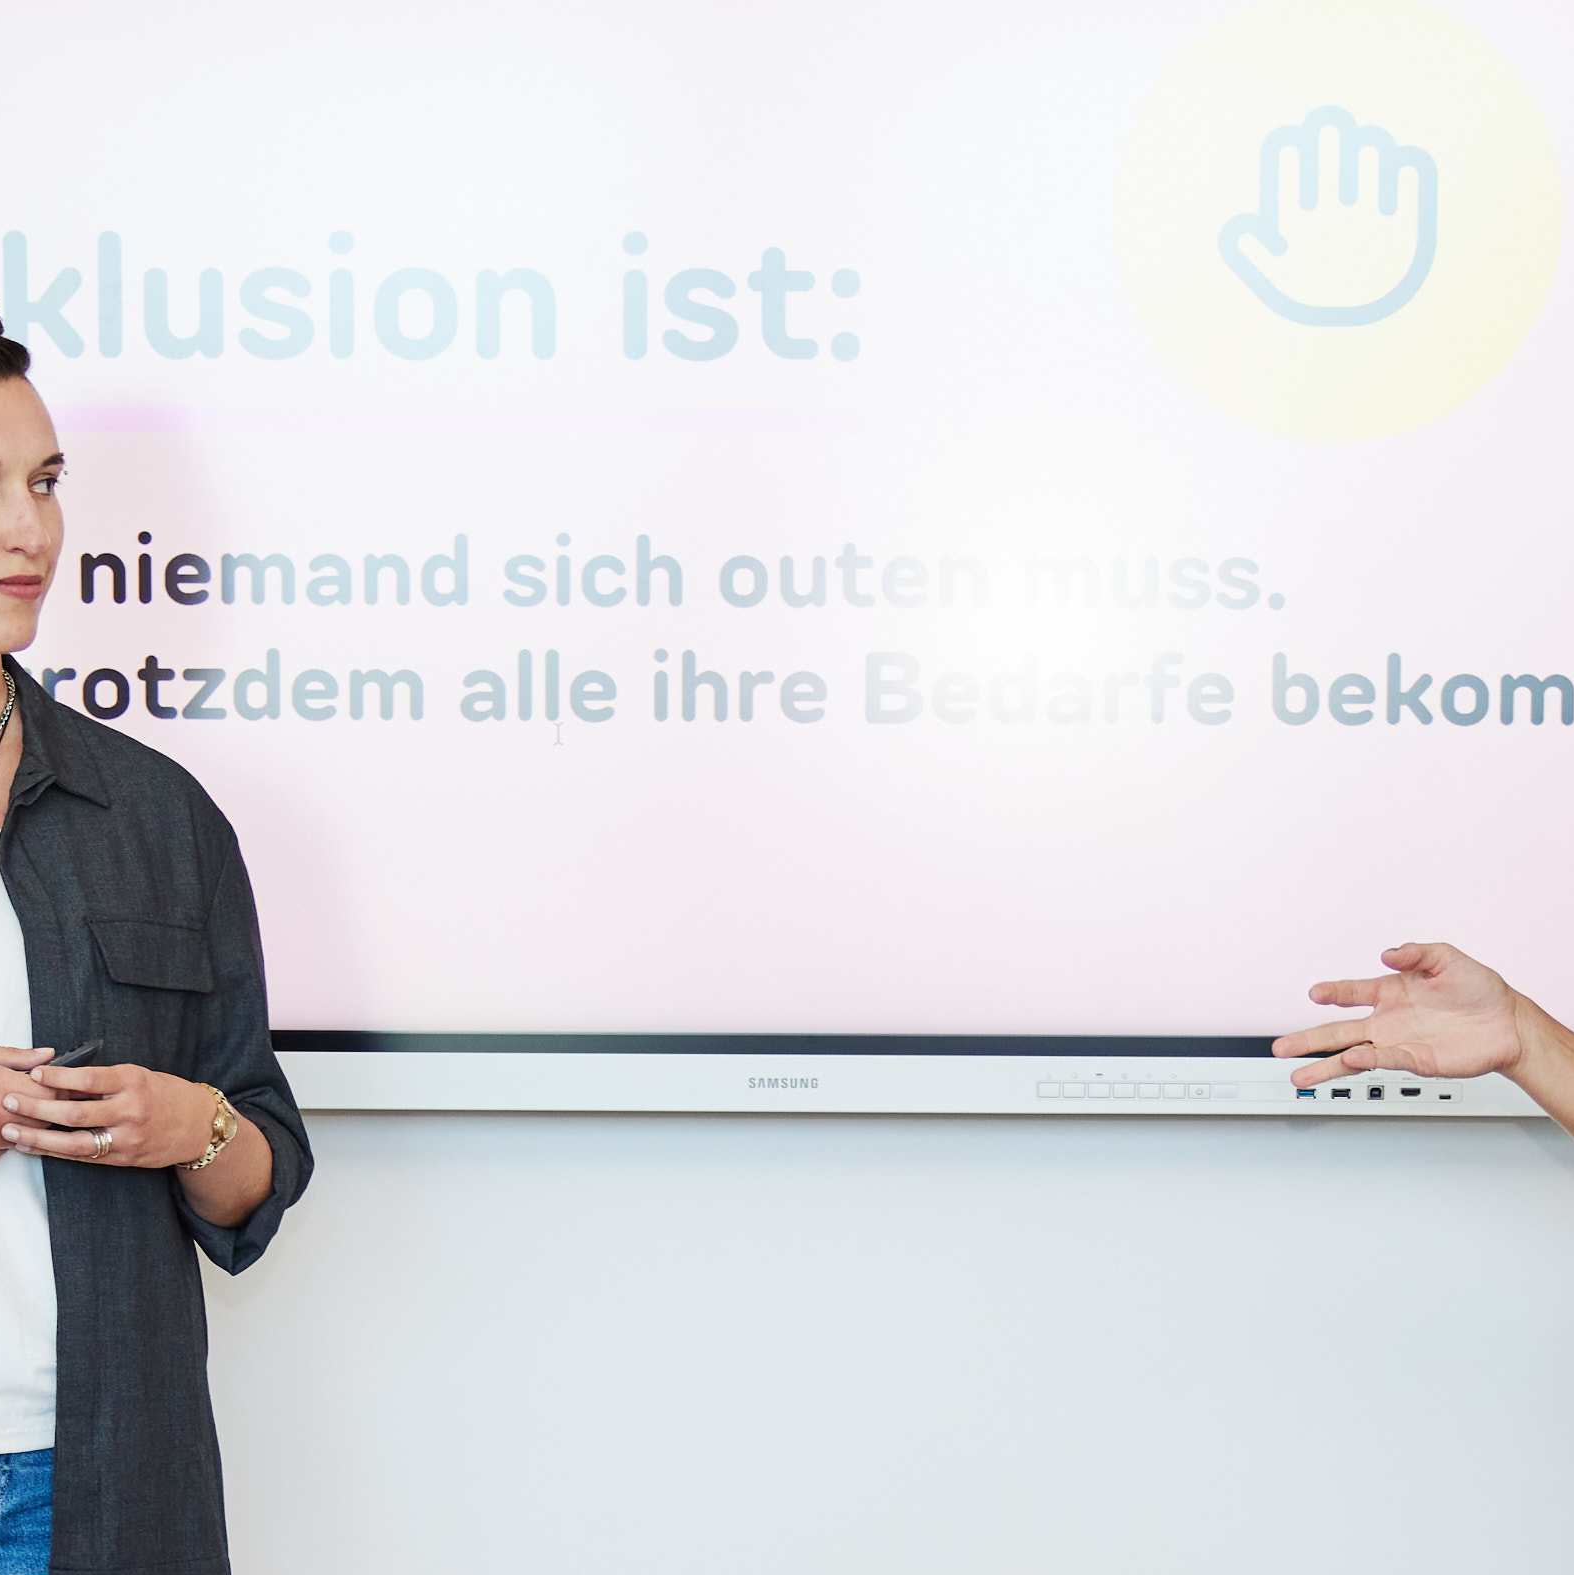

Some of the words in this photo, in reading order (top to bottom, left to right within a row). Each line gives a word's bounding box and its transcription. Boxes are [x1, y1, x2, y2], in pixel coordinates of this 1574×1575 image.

[620, 230, 862, 363] ist:
[79, 530, 469, 608] niemand
[503, 532, 684, 608] sich
[719, 542, 986, 608] outen
[1029, 556, 1287, 612] muss.
[26, 648, 425, 721] rotzdem
[460, 648, 619, 724] alle
[653, 648, 828, 724] ihre
[865, 651, 1235, 726] Bedarfe
[748, 1077, 819, 1089] SAMSUNG
